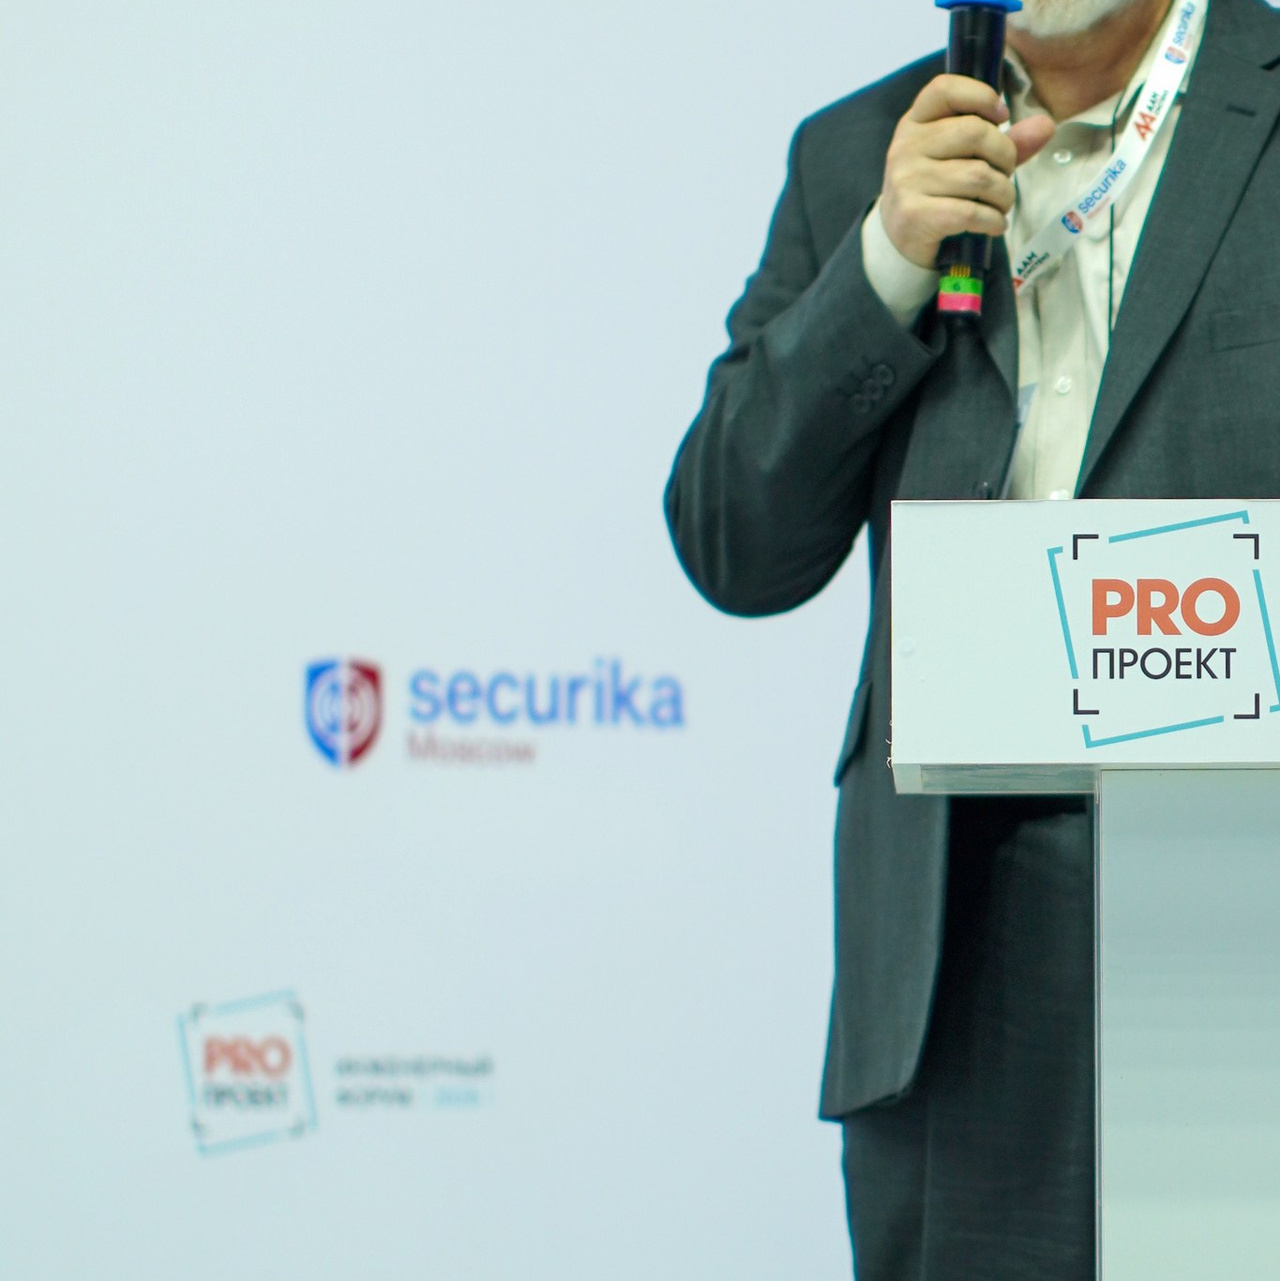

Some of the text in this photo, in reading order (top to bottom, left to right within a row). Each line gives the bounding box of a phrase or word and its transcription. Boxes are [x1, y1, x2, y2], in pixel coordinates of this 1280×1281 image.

[1078, 159, 1126, 213] securika
[1091, 578, 1241, 637] PRO
[1092, 648, 1237, 680] ПРОЕКТ
[408, 657, 686, 729] securika
[204, 1036, 292, 1081] PRO
